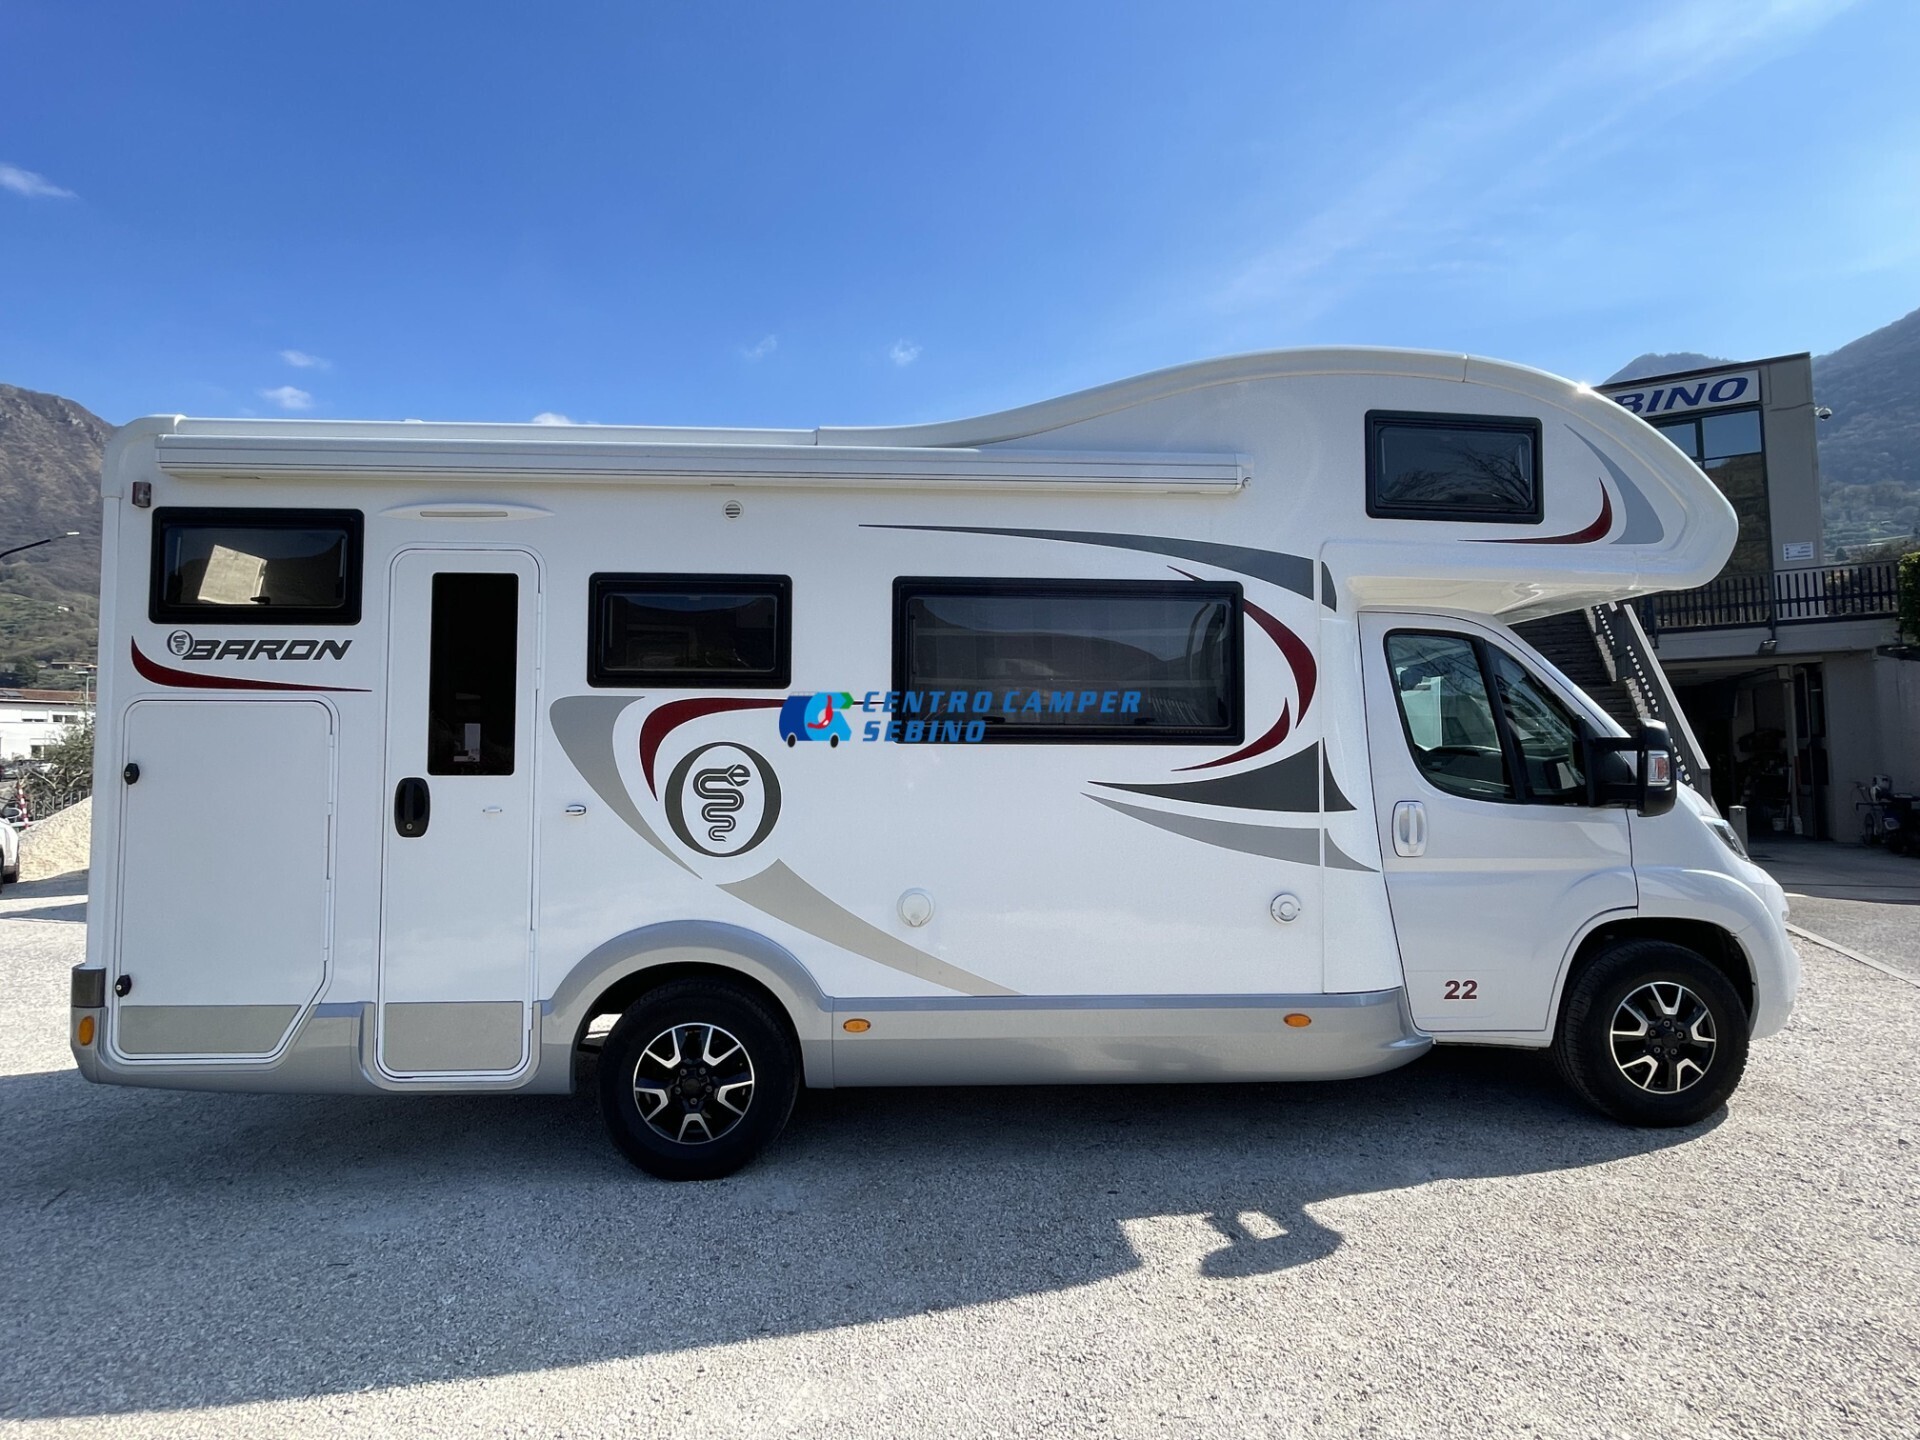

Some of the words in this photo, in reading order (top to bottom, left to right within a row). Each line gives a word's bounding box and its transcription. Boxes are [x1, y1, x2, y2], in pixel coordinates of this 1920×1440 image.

[1615, 377, 1749, 414] BINO
[182, 640, 353, 660] BARON
[1444, 980, 1478, 1000] 22
